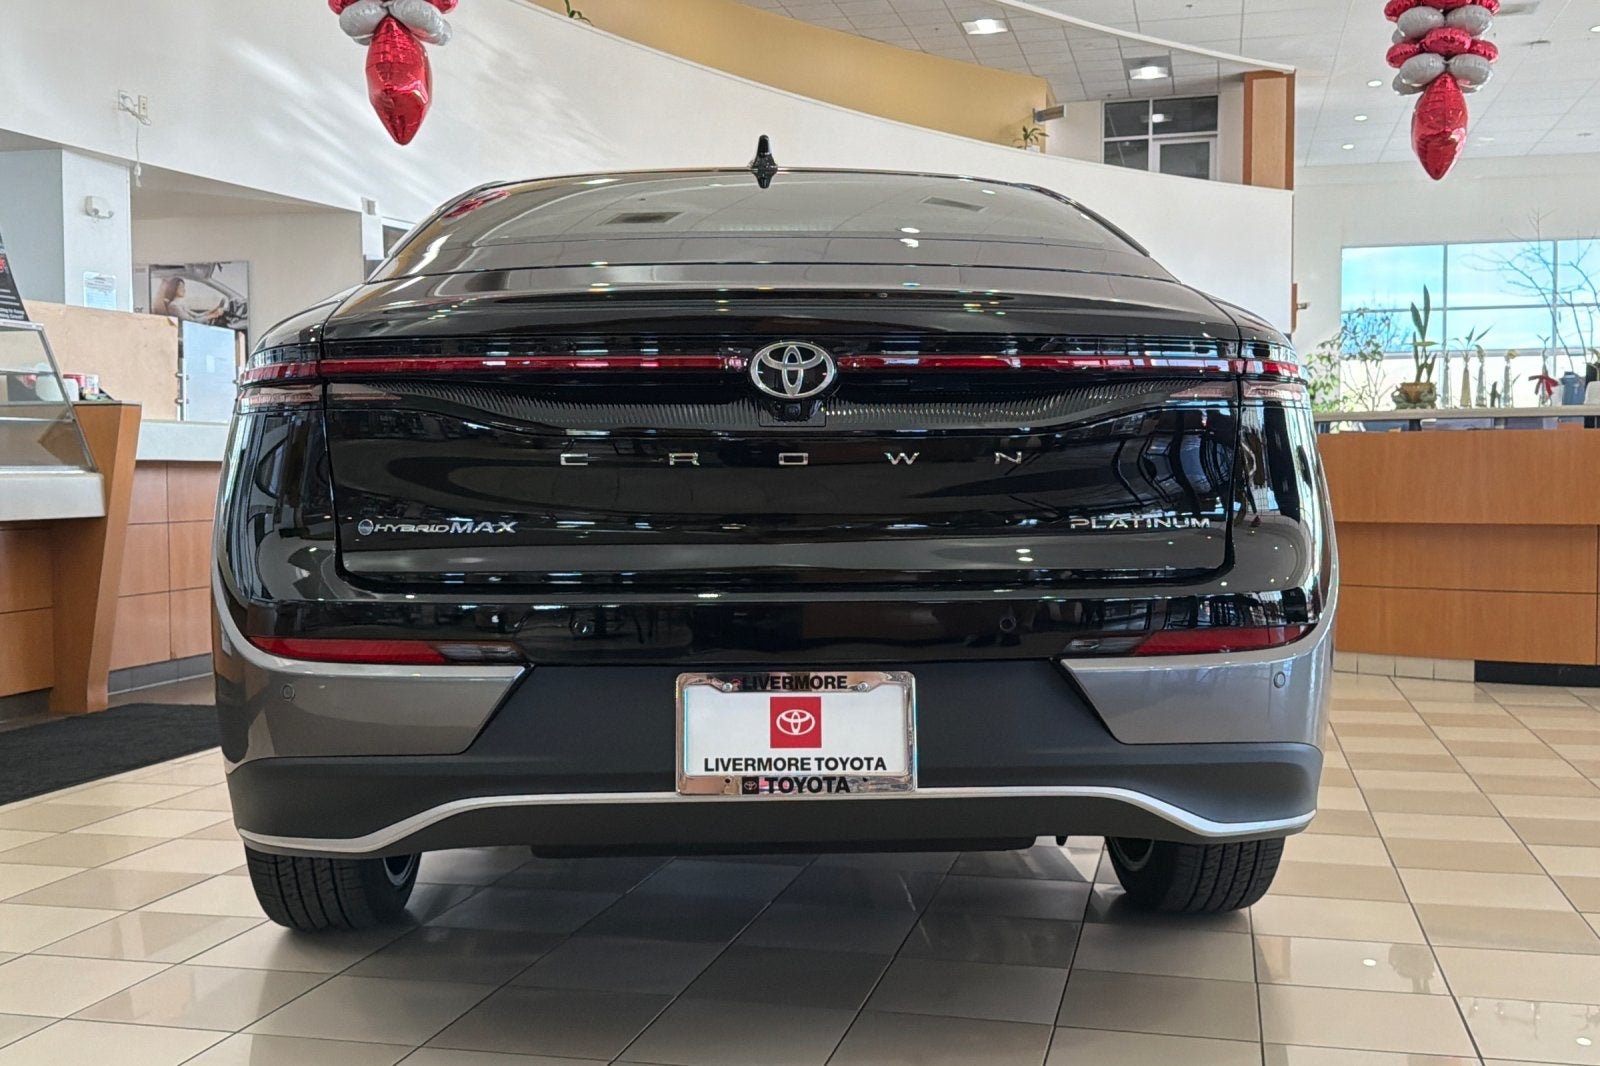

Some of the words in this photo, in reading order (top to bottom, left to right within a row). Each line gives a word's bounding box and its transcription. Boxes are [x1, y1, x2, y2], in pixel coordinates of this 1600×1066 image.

[1070, 517, 1210, 529] PLATINUM
[742, 675, 847, 690] LIVERMORE
[704, 757, 811, 771] LIVERMORE
[815, 757, 886, 771] TOYOTA
[765, 777, 850, 793] TOYOTA
